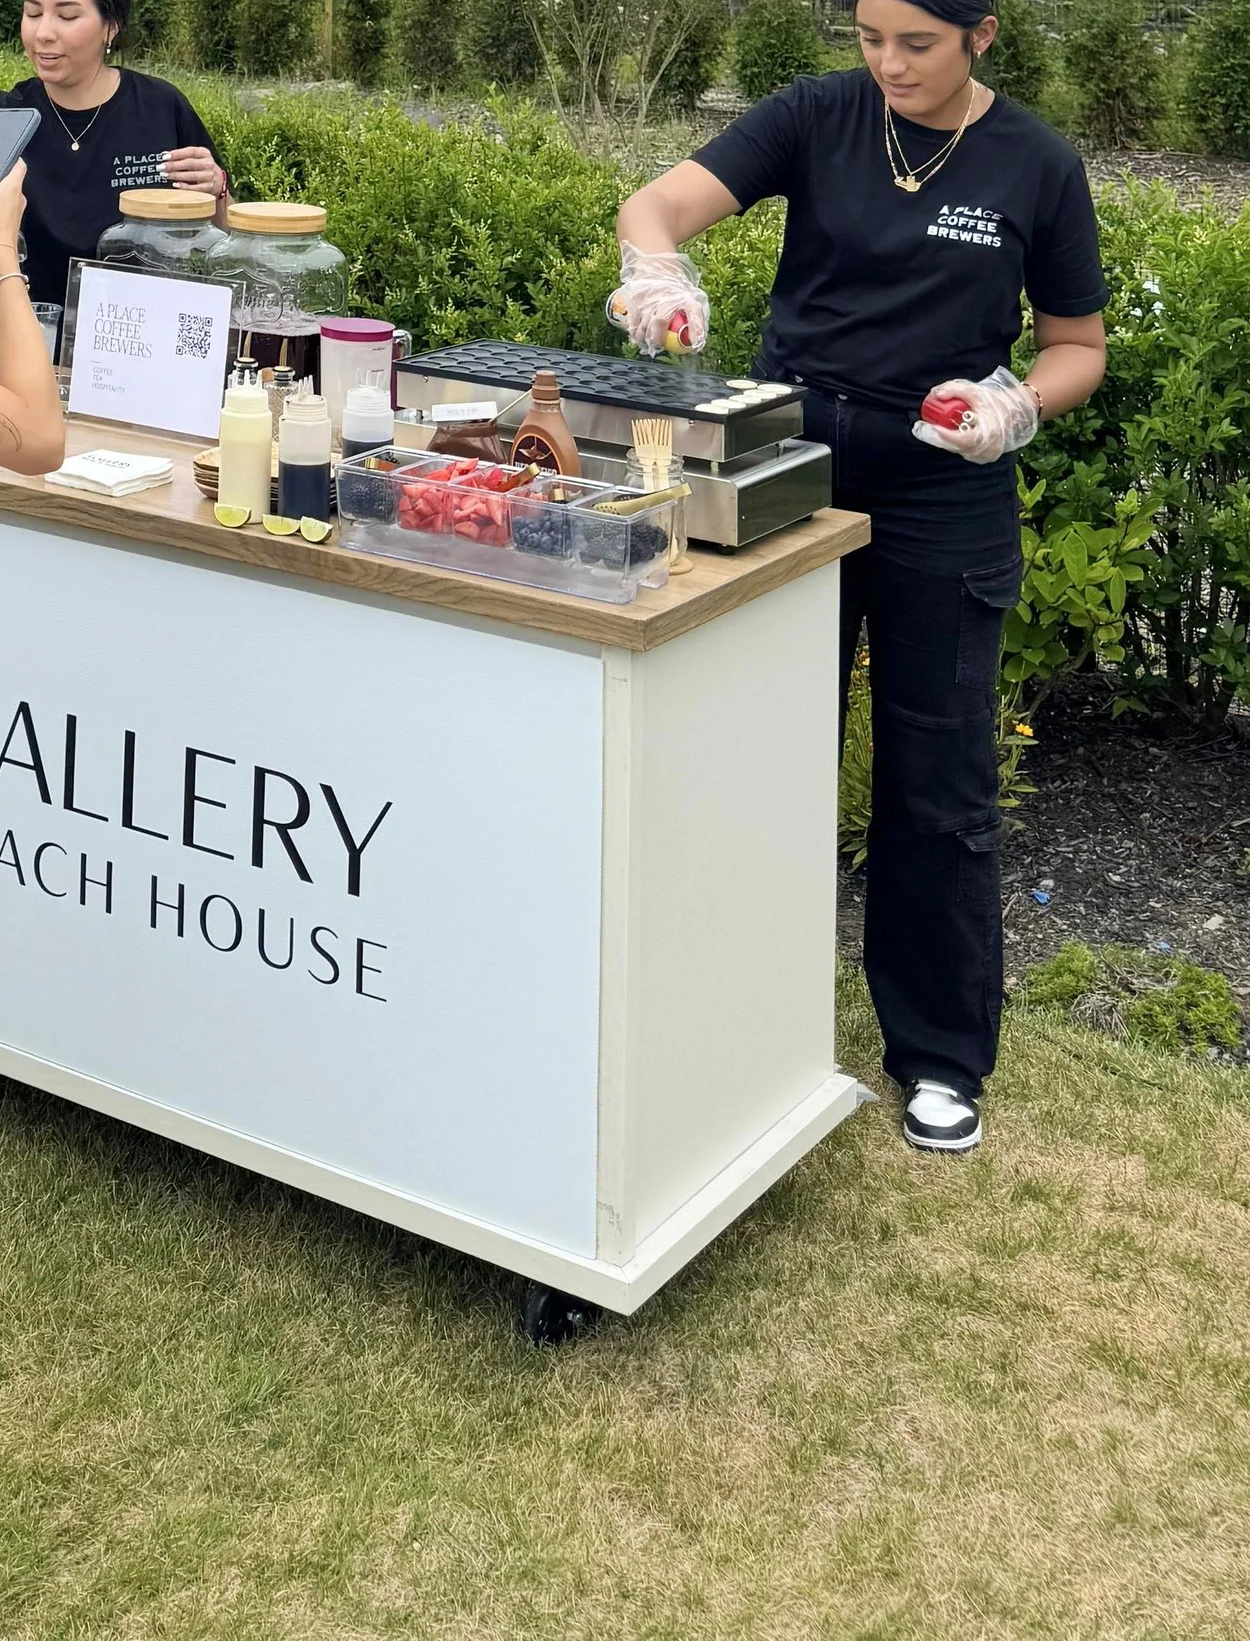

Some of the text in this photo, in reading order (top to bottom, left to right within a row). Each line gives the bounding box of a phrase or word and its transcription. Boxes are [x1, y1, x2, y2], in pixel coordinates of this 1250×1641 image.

[113, 153, 163, 165] A PLACE
[111, 174, 168, 188] BREWERS
[939, 205, 1004, 221] A PLACE
[937, 215, 997, 233] COFFEE
[926, 225, 1002, 248] BREWERS
[95, 302, 146, 323] A PLACE
[94, 318, 141, 340] COFFEE
[93, 334, 153, 359] BREWERS
[150, 874, 388, 1003] HOUSE
